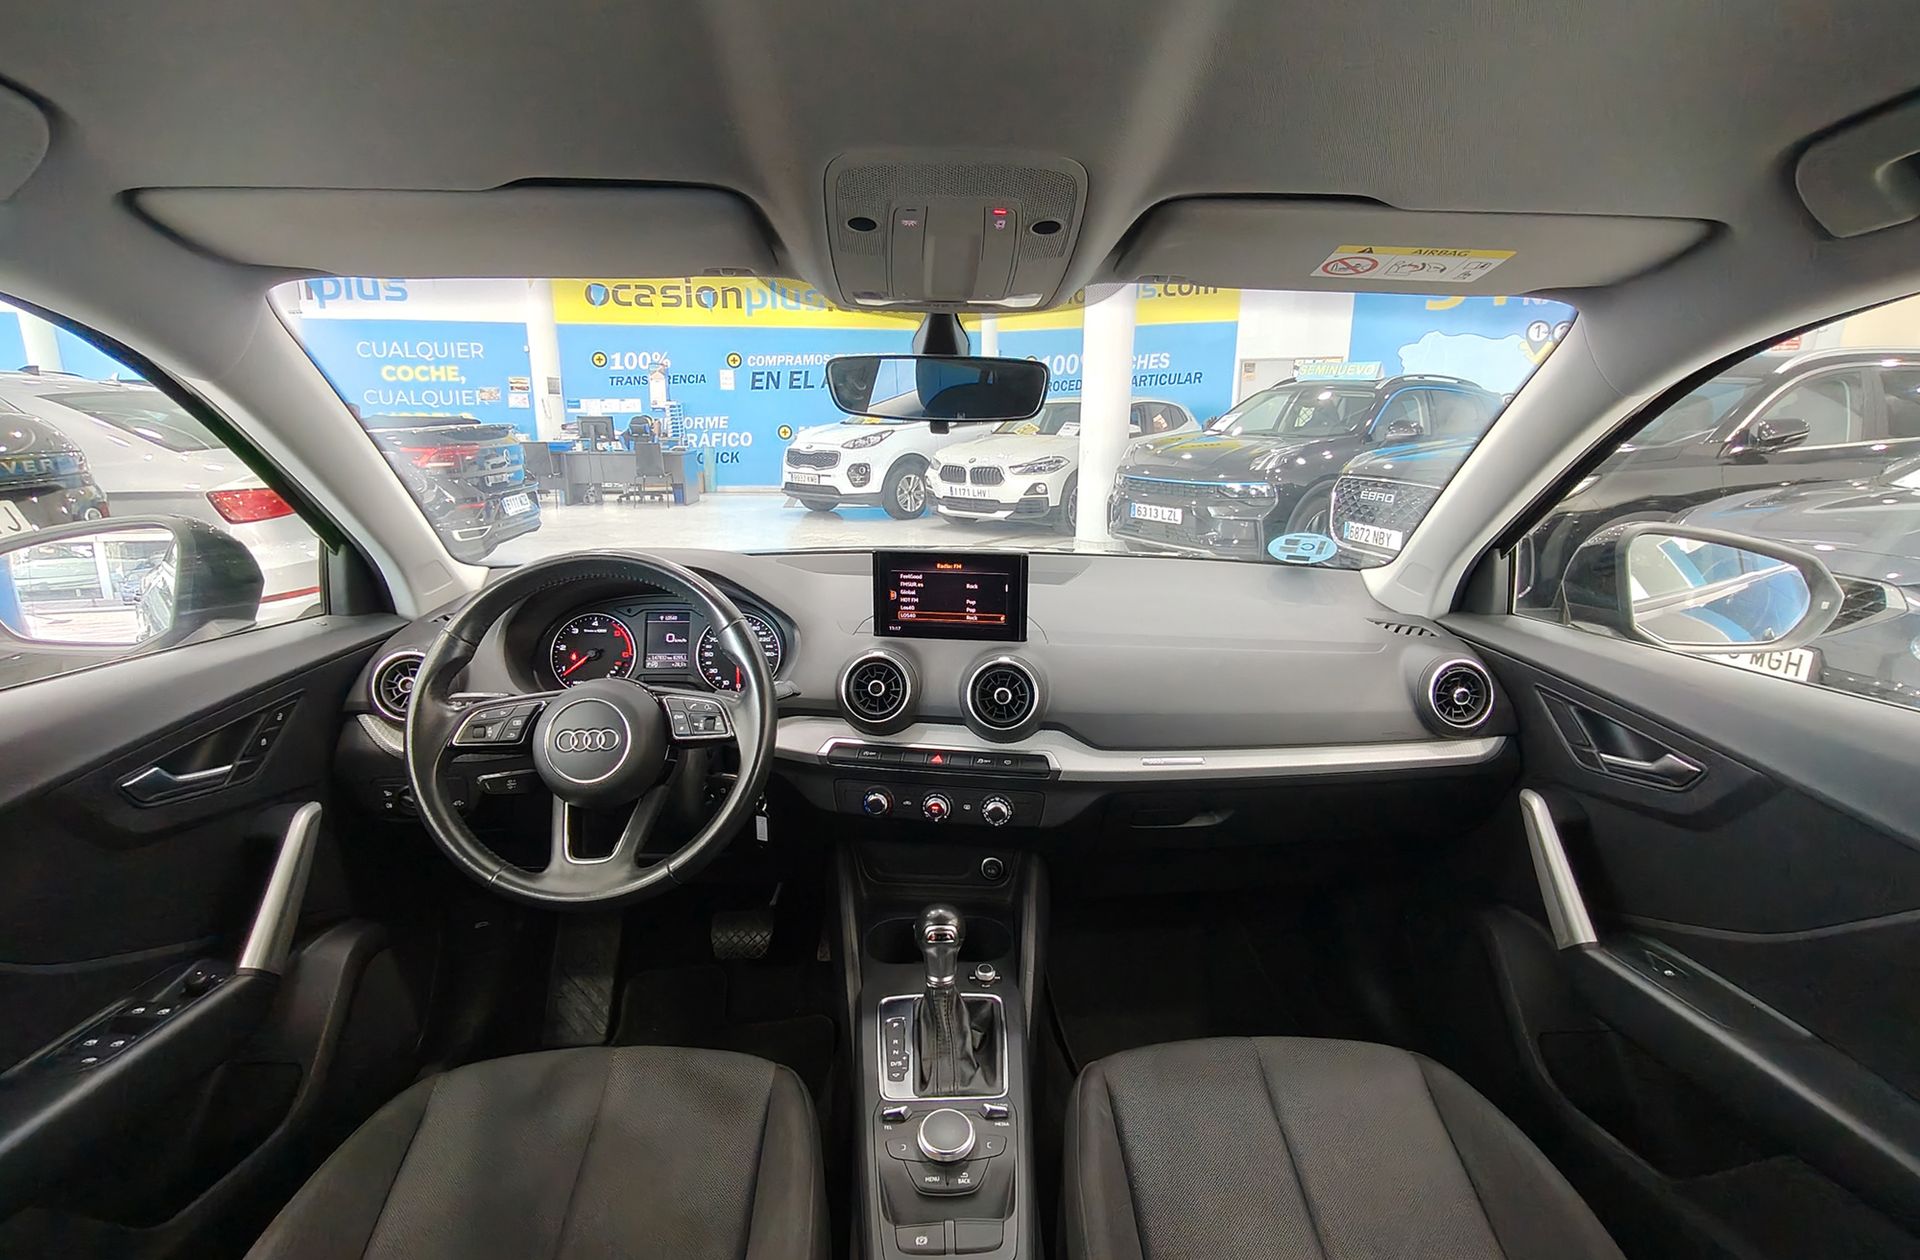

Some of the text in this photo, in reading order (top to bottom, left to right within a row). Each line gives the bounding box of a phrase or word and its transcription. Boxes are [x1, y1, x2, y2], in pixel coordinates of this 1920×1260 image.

[1411, 249, 1471, 257] AIRBAG
[356, 341, 484, 360] CUALQUIER
[747, 354, 830, 366] COMPRAMOS
[609, 351, 671, 371] 100%
[1044, 352, 1170, 376] 100 CHES
[1300, 363, 1377, 376] SEMINUEVO
[381, 365, 466, 384] COCHE,
[609, 373, 707, 386] TRANSRENCIA
[751, 371, 780, 390] EN
[789, 370, 814, 389] EL
[1048, 371, 1203, 393] ROCED ARTICULAR
[686, 429, 753, 448] RÁFICO
[697, 451, 740, 464] CICK
[1360, 490, 1395, 503] EBRO
[1137, 506, 1179, 521] 6313 LZL
[1350, 526, 1393, 547] 6872 NBY
[1749, 652, 1804, 677] MGH
